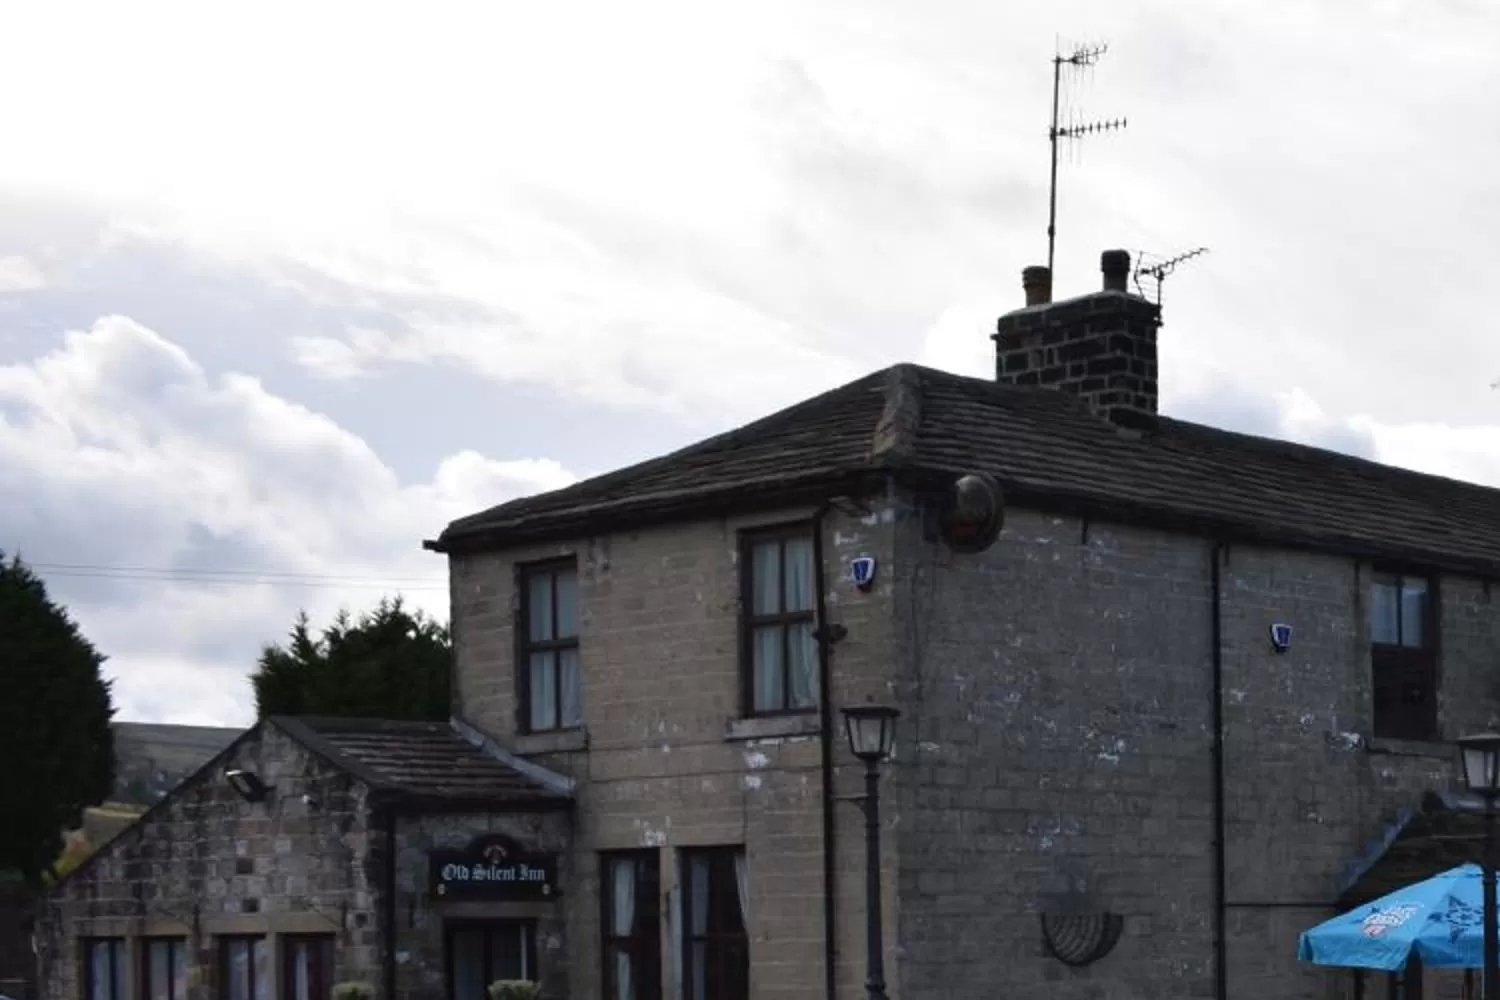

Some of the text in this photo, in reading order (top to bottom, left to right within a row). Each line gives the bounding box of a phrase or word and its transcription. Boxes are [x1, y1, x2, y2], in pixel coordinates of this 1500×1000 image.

[442, 863, 545, 881] Old Silent Inn
